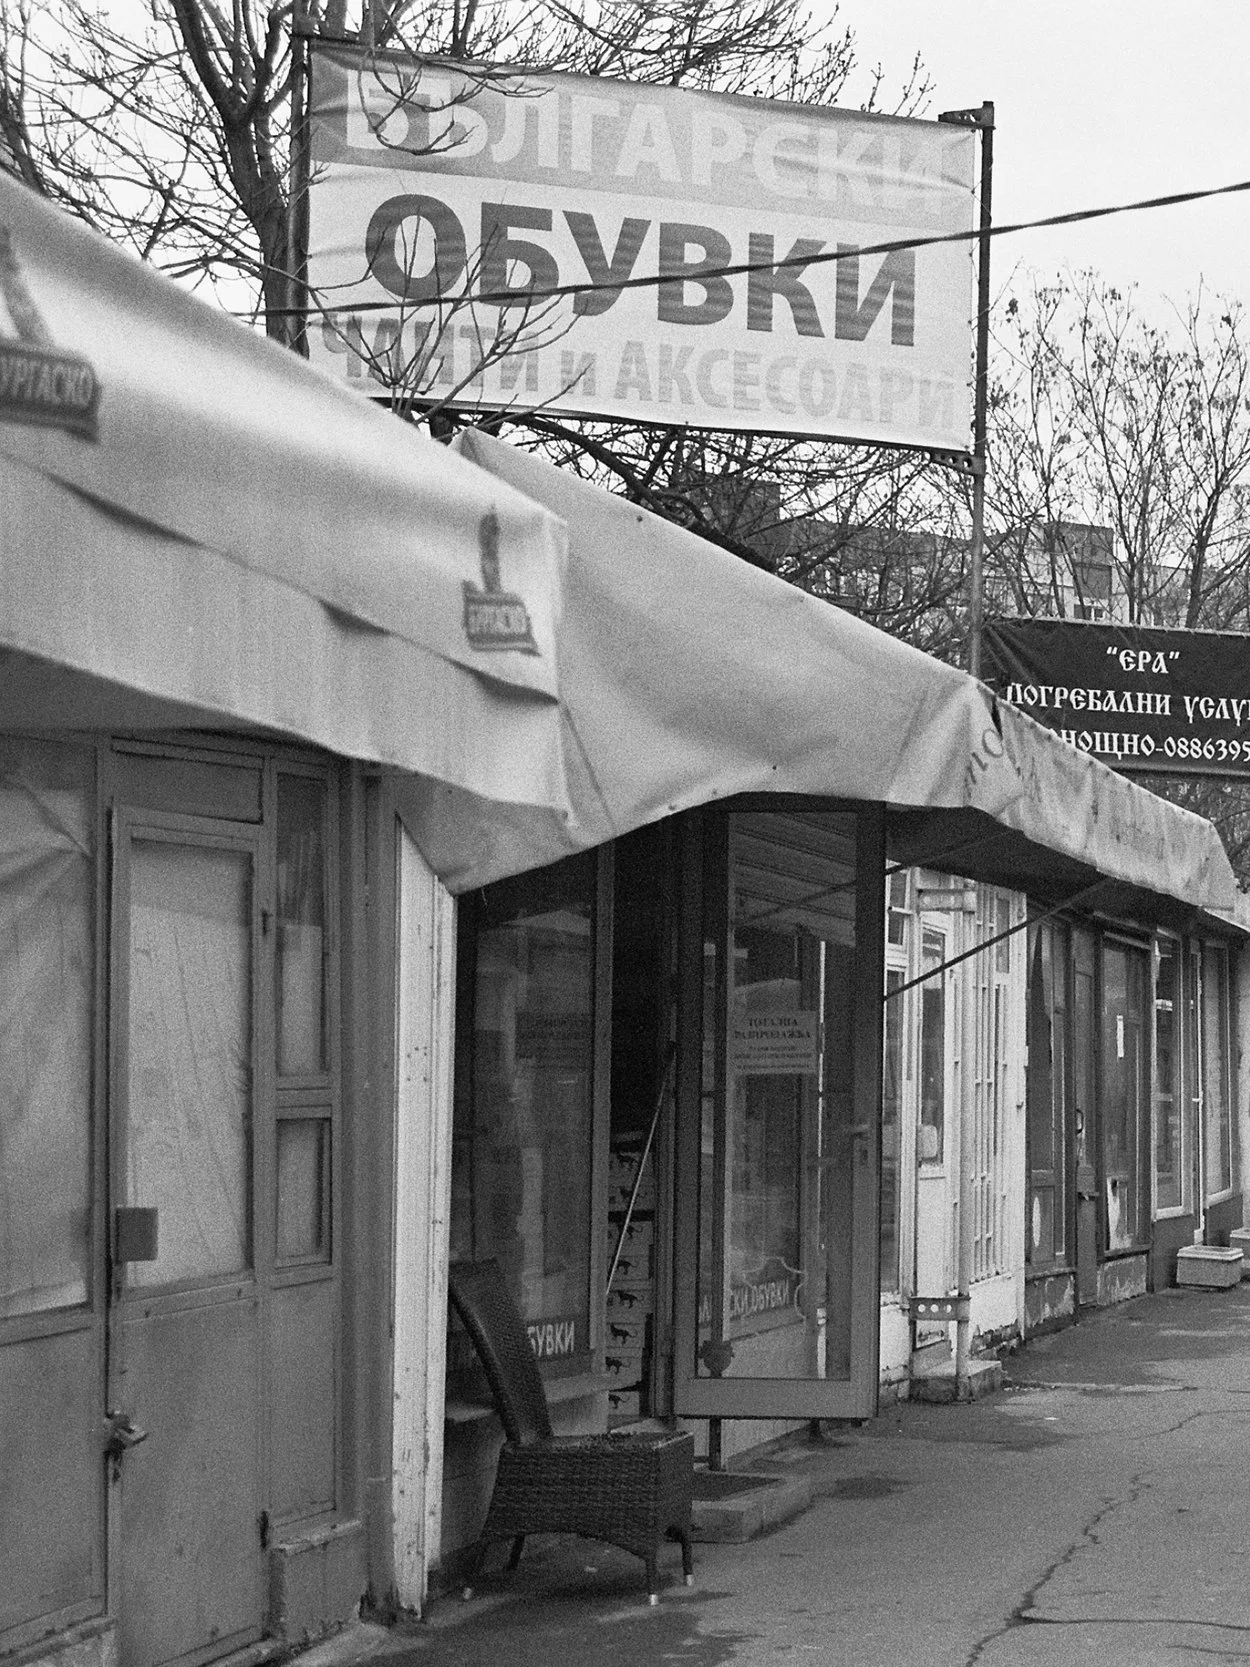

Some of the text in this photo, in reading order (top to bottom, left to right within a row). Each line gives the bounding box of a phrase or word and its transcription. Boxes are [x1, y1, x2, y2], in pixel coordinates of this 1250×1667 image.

[365, 193, 917, 347] ОБУВКИ
[613, 340, 957, 428] АКСЕСОАРИ
[1005, 682, 1172, 716] ПОГРЕБАЛНИ
